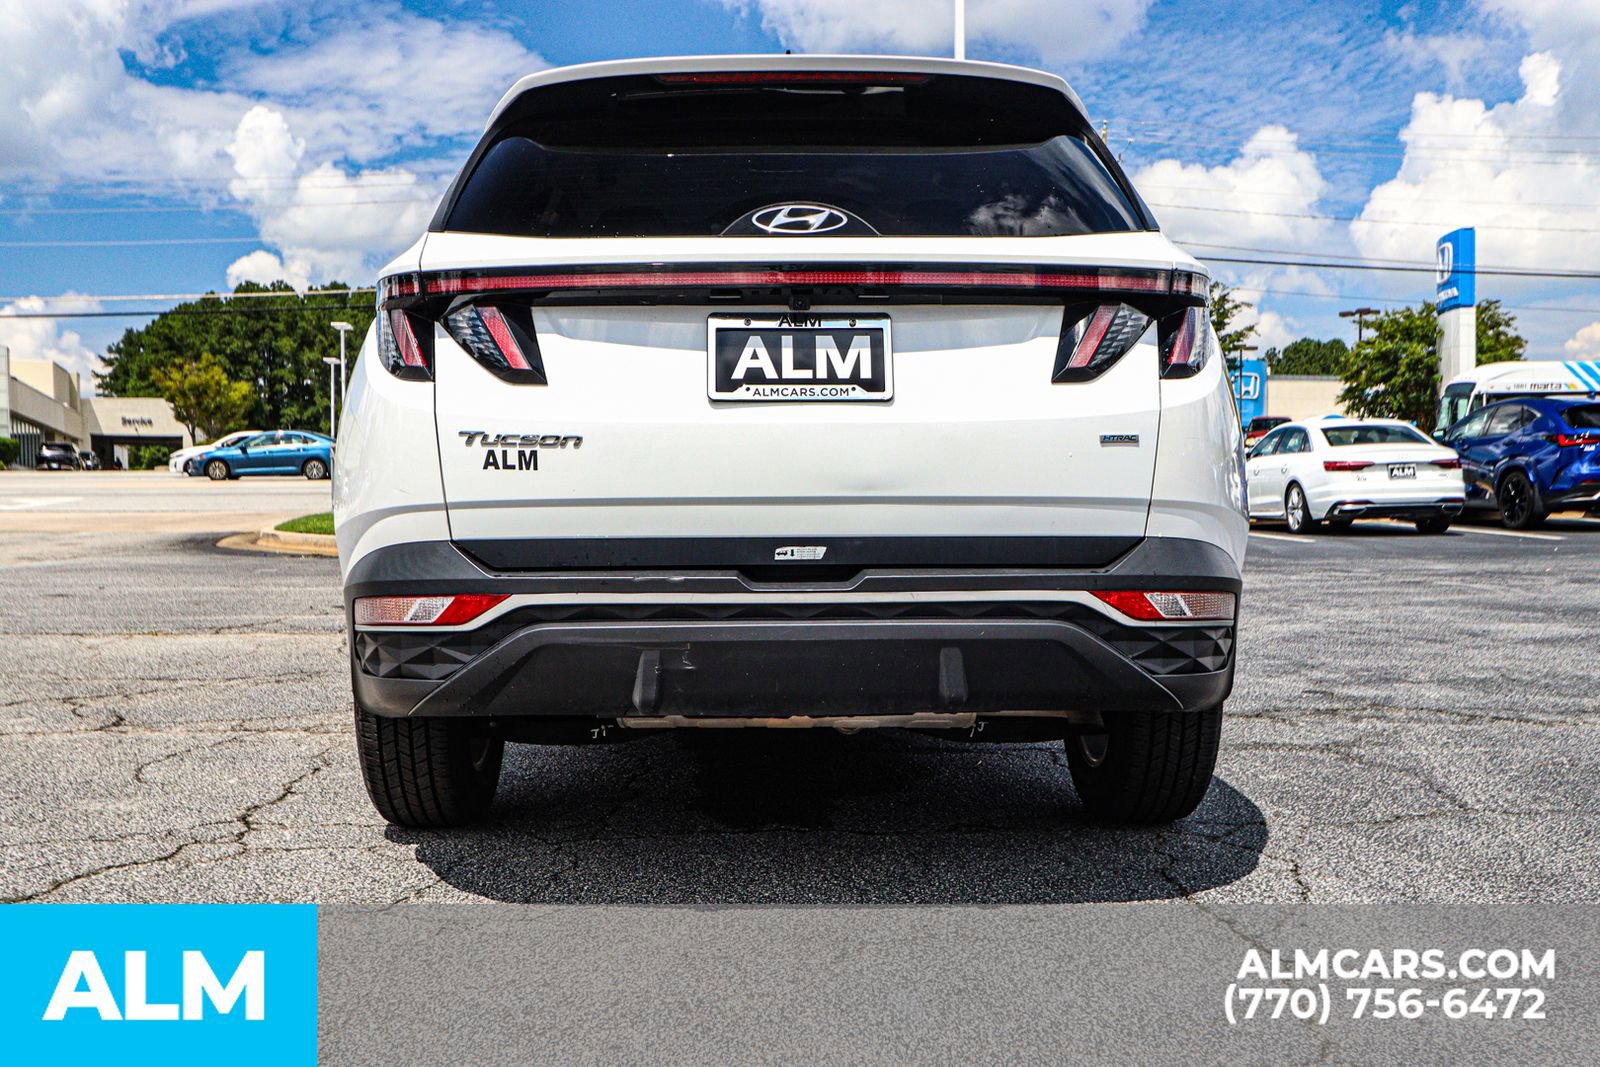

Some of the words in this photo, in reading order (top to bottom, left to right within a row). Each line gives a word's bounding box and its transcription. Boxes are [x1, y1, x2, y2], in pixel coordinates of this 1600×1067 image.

[730, 335, 872, 380] ALM
[752, 387, 850, 397] ALMCARS.COM
[121, 416, 153, 427] Service
[482, 449, 538, 471] ALM
[1391, 467, 1415, 477] ALM
